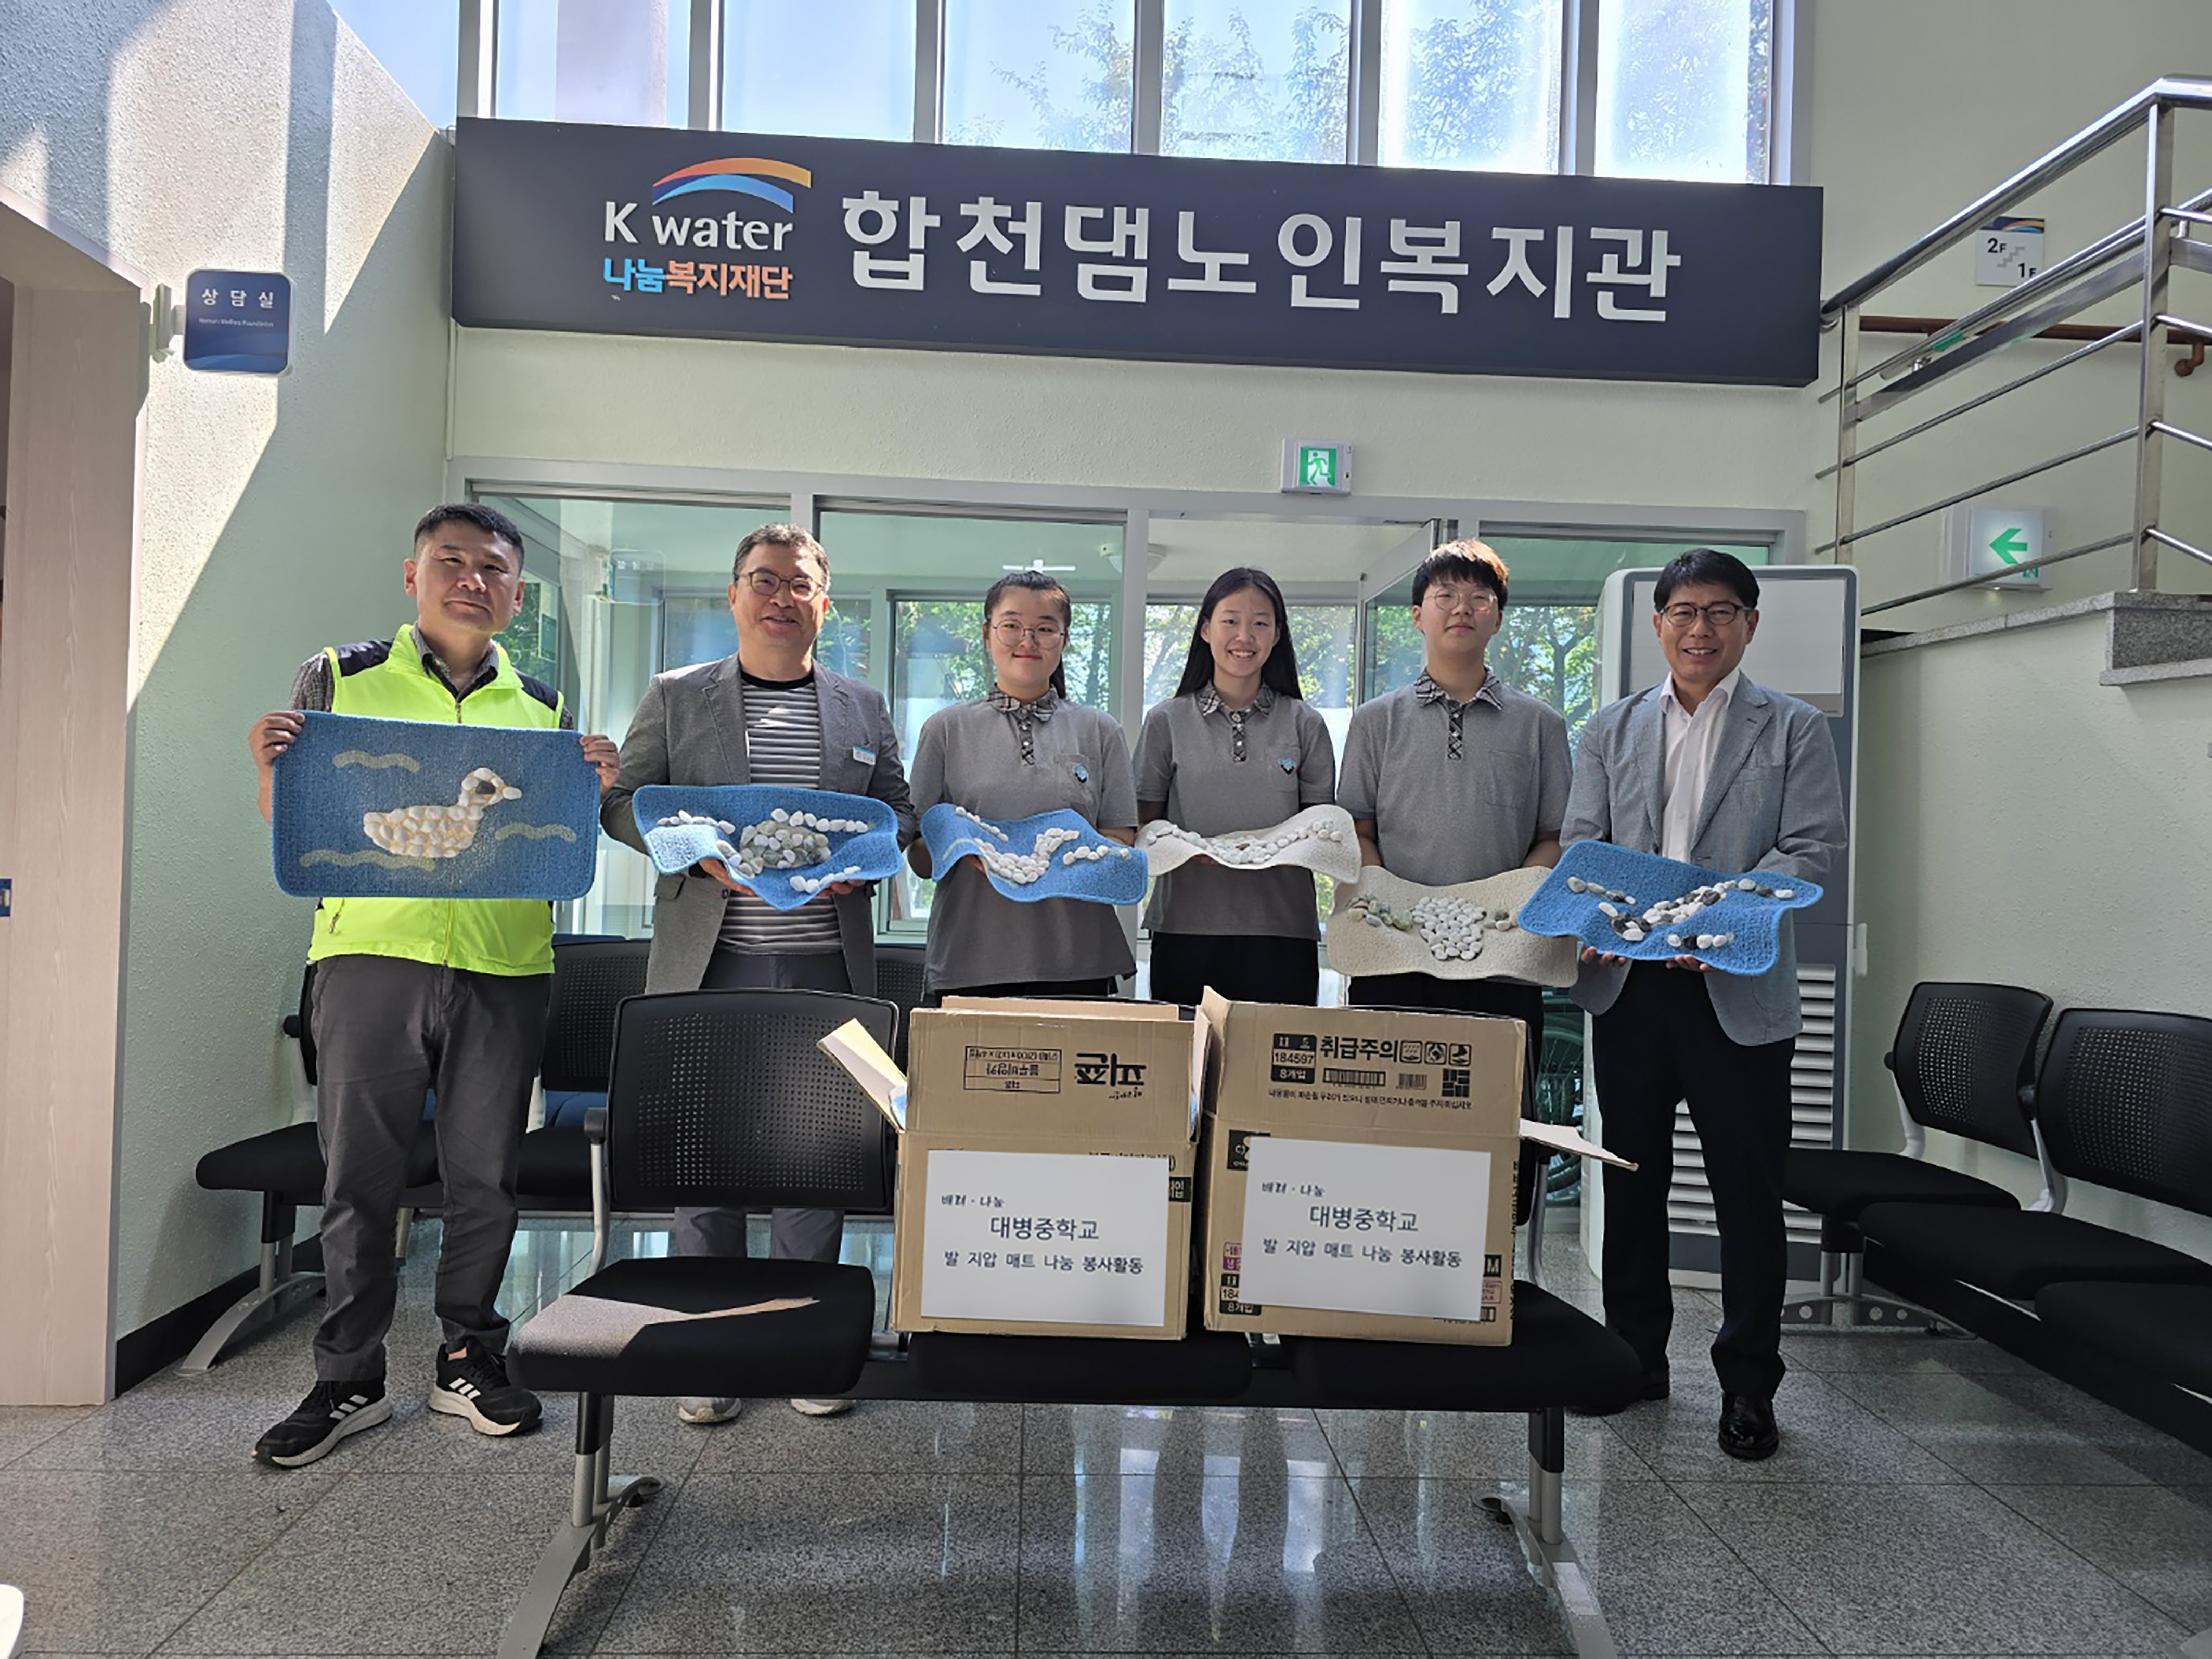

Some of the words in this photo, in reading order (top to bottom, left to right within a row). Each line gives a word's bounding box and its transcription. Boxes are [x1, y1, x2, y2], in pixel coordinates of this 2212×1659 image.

[605, 201, 638, 243] K
[651, 211, 793, 252] water
[842, 190, 1681, 323] 합천댐노인복지관
[1987, 238, 2007, 253] 2F
[603, 257, 793, 300] 나눔복지재단
[2018, 262, 2037, 278] 1F
[1275, 1052, 1314, 1065] 184597
[1320, 1036, 1398, 1062] 취급주의
[986, 1063, 1039, 1077] 블루비앙카
[1074, 1052, 1147, 1087] 피죤
[1279, 1068, 1306, 1080] 8개입
[941, 1194, 966, 1206] 배려
[980, 1196, 1005, 1208] 나눔
[1262, 1182, 1287, 1194] 배려
[1300, 1185, 1326, 1197] 나눔
[991, 1216, 1099, 1241] 대병중학교
[1309, 1206, 1419, 1232] 대병중학교
[944, 1251, 959, 1266] 발
[968, 1251, 998, 1268] 지압
[1006, 1253, 1035, 1269] 매트
[1044, 1254, 1074, 1270] 나눔
[1082, 1256, 1144, 1275] 봉사활동
[1263, 1238, 1278, 1254] 발
[1286, 1240, 1316, 1257] 지압
[1324, 1242, 1354, 1258] 매트
[1362, 1245, 1392, 1263] 나눔
[1400, 1248, 1462, 1268] 봉사활동
